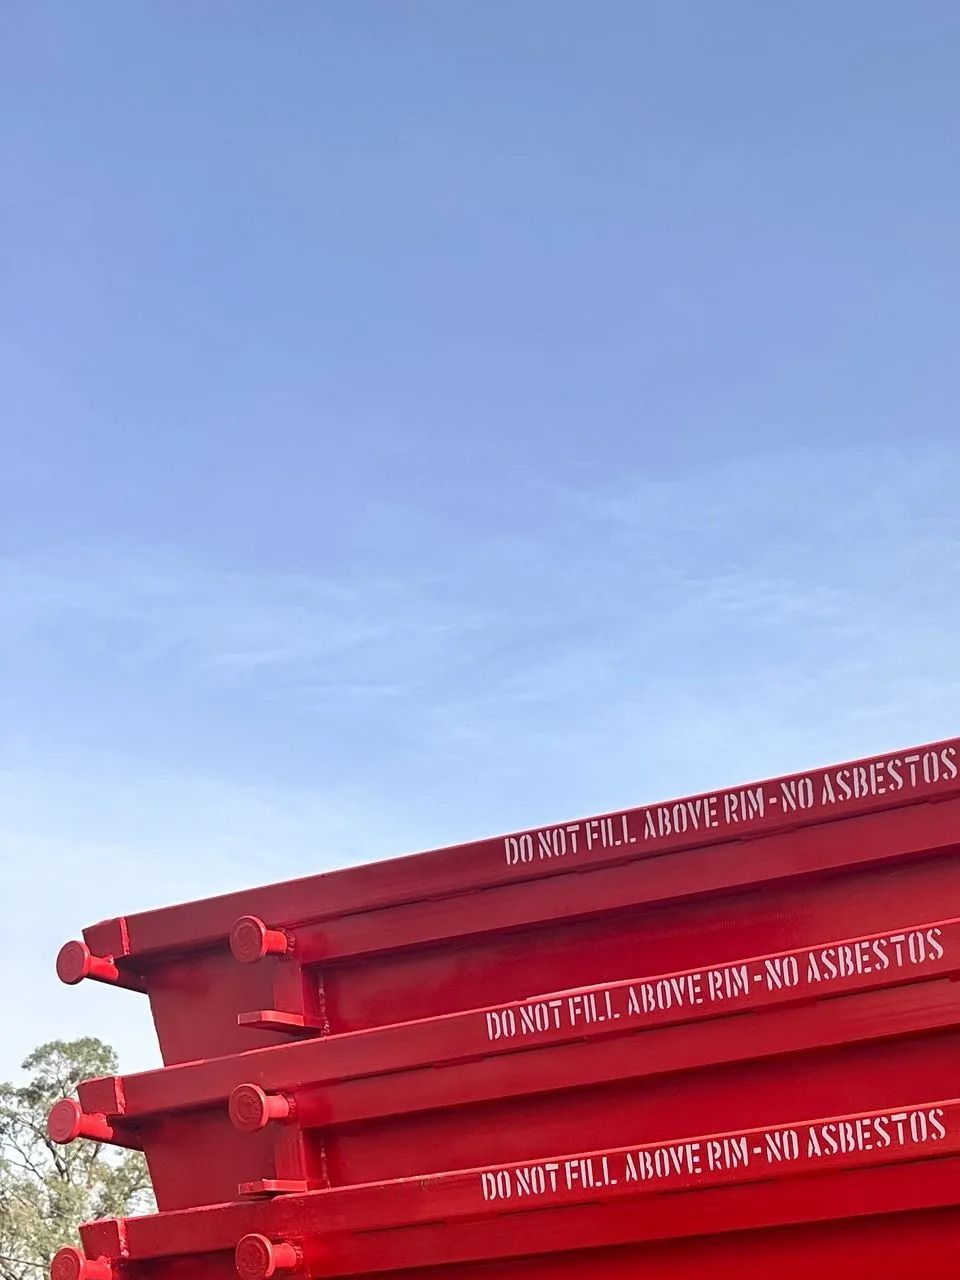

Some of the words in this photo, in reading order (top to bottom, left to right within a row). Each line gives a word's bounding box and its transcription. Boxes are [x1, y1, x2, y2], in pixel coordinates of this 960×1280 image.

[504, 834, 533, 865] DO
[538, 825, 580, 859] NOT
[585, 819, 637, 851] FILL
[643, 797, 719, 840] ABOVE
[821, 747, 958, 805] ASBESTOS
[486, 1011, 516, 1041] DO
[520, 1000, 562, 1034] NOT
[568, 995, 621, 1027] FILL
[627, 973, 702, 1015] ABOVE
[807, 928, 944, 983] ASBESTOS
[481, 1171, 512, 1201] DO
[516, 1163, 559, 1197] NOT
[564, 1156, 618, 1190] FILL
[625, 1143, 702, 1182] ABOVE
[807, 1108, 946, 1158] ASBESTOS
